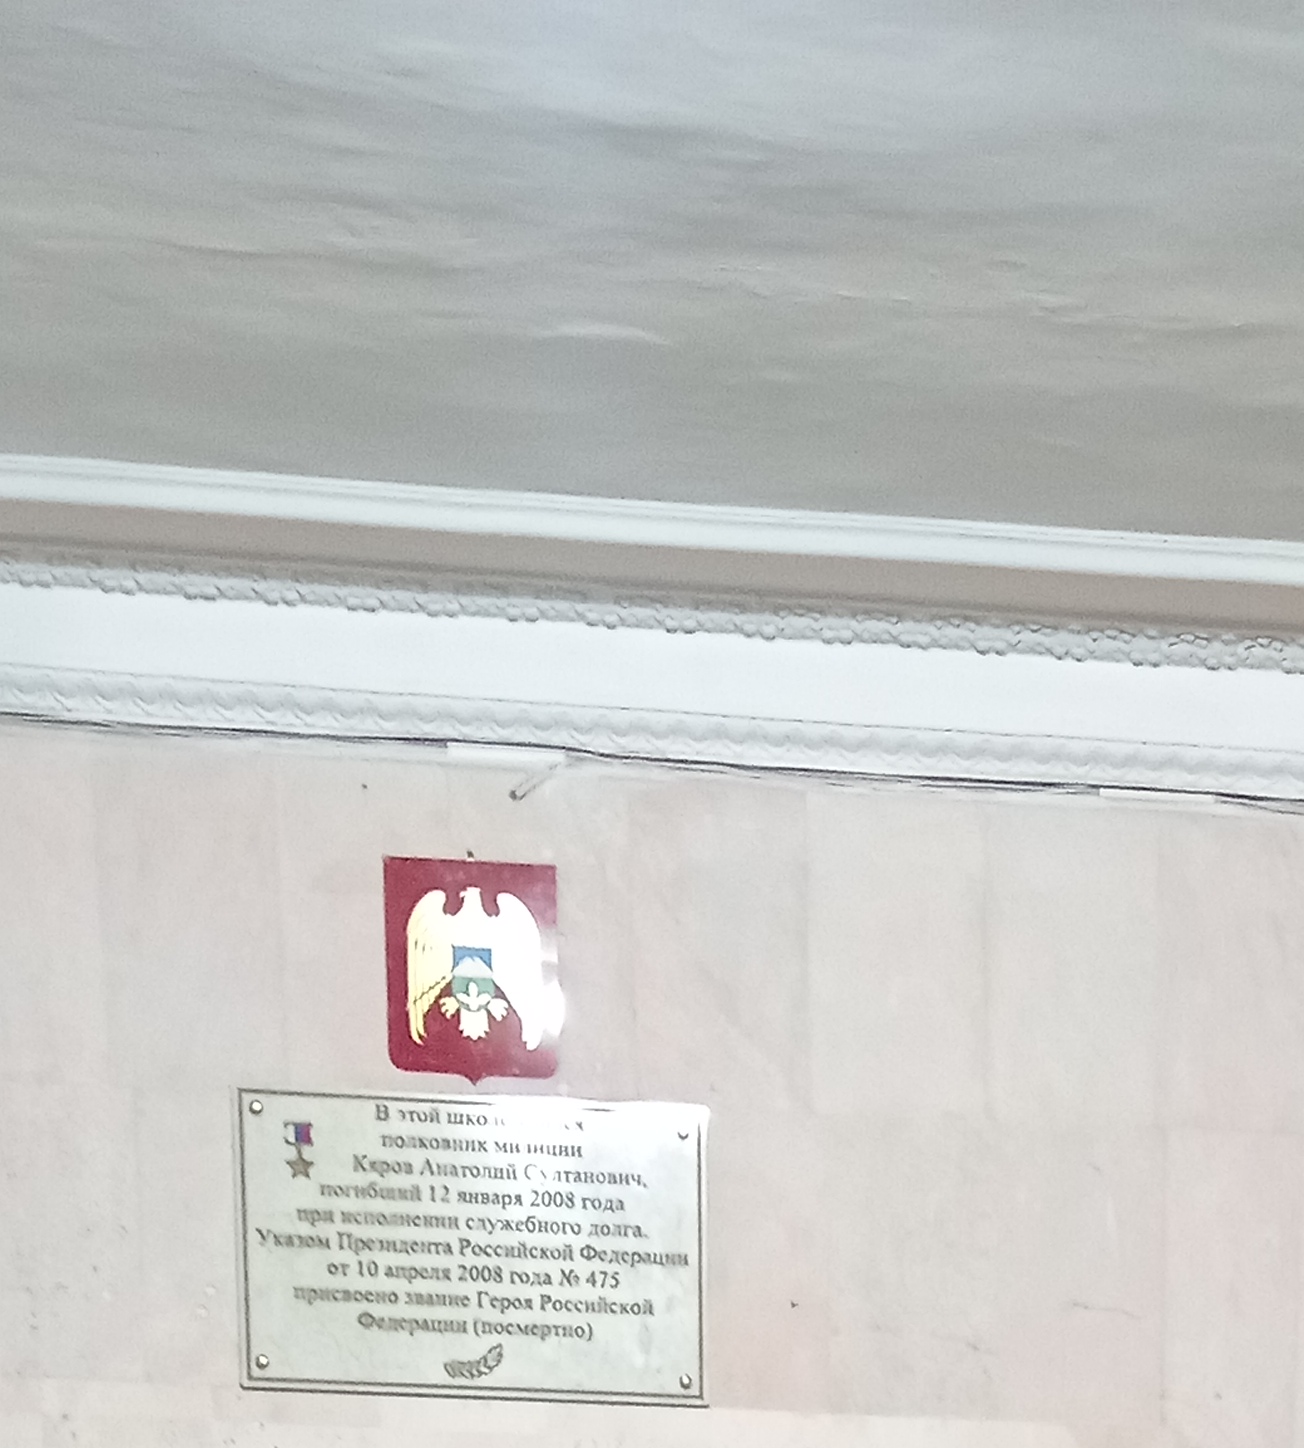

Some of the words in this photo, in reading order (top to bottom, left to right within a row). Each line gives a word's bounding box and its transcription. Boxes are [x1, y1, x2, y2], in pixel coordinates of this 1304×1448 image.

[375, 1103, 390, 1121] В
[399, 1107, 440, 1124] этой
[381, 1133, 488, 1153] полковник
[352, 1154, 413, 1178] Кяров
[420, 1158, 517, 1181] Анатолий
[320, 1182, 422, 1202] погибший
[429, 1185, 450, 1203] 12
[457, 1191, 523, 1209] января
[531, 1190, 575, 1209] 2008
[581, 1198, 625, 1213] года
[297, 1208, 334, 1227] при
[341, 1213, 459, 1230] исполнении
[466, 1215, 581, 1236] служебного
[588, 1222, 649, 1239] долга.
[256, 1228, 331, 1251] Указом
[336, 1231, 453, 1255] Президента
[458, 1236, 574, 1262] Российской
[579, 1244, 689, 1268] Федерации
[327, 1262, 350, 1276] от
[357, 1260, 379, 1277] 10
[384, 1265, 452, 1283] апреля
[458, 1263, 503, 1283] 2008
[509, 1270, 553, 1286] года
[558, 1268, 580, 1287] №
[585, 1270, 620, 1288] 475
[293, 1285, 399, 1305] присвоено
[404, 1291, 470, 1307] звание
[476, 1290, 533, 1314] Героя
[540, 1294, 655, 1316] Российской
[357, 1311, 468, 1335] Федерации
[473, 1318, 593, 1341] (посмертно)
